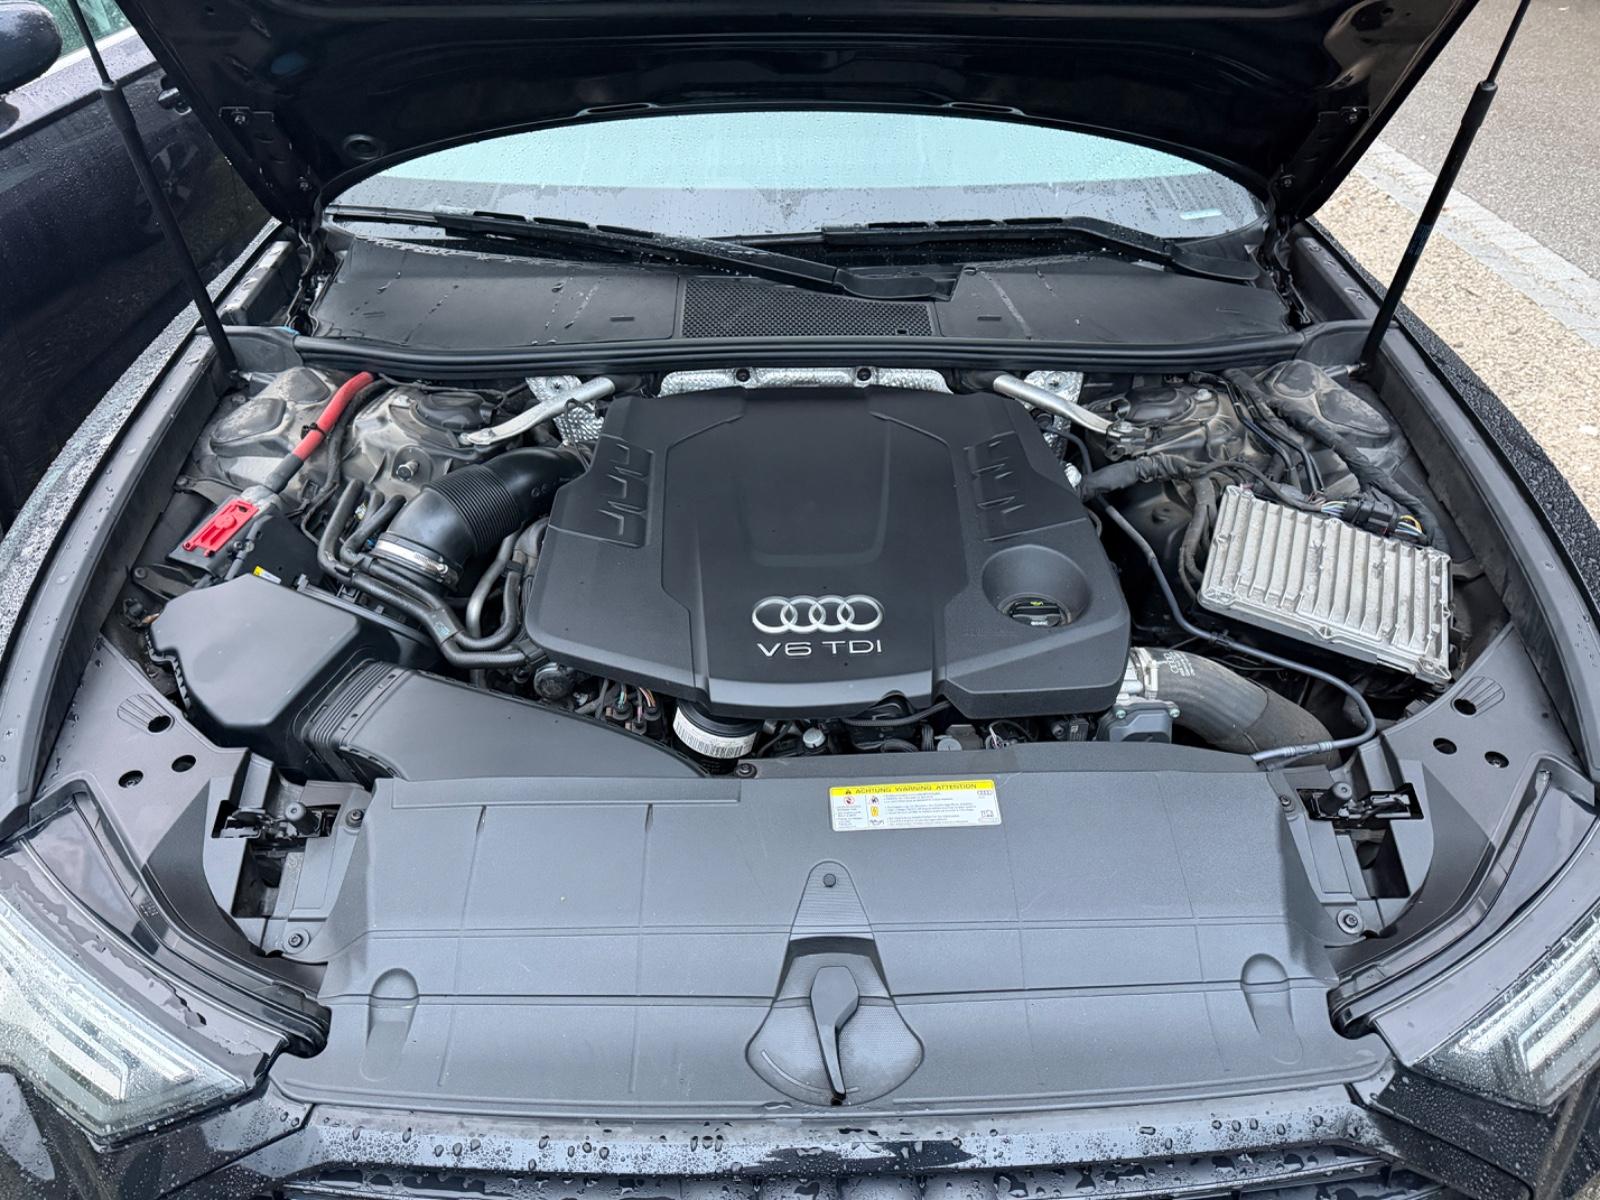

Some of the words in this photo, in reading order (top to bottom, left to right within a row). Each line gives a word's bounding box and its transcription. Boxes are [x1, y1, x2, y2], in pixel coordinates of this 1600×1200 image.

[757, 641, 812, 657] V6
[821, 639, 882, 654] TDI
[855, 786, 892, 794] ACHTUNG
[895, 784, 932, 792] WARNING
[936, 782, 977, 790] ATTENTION
